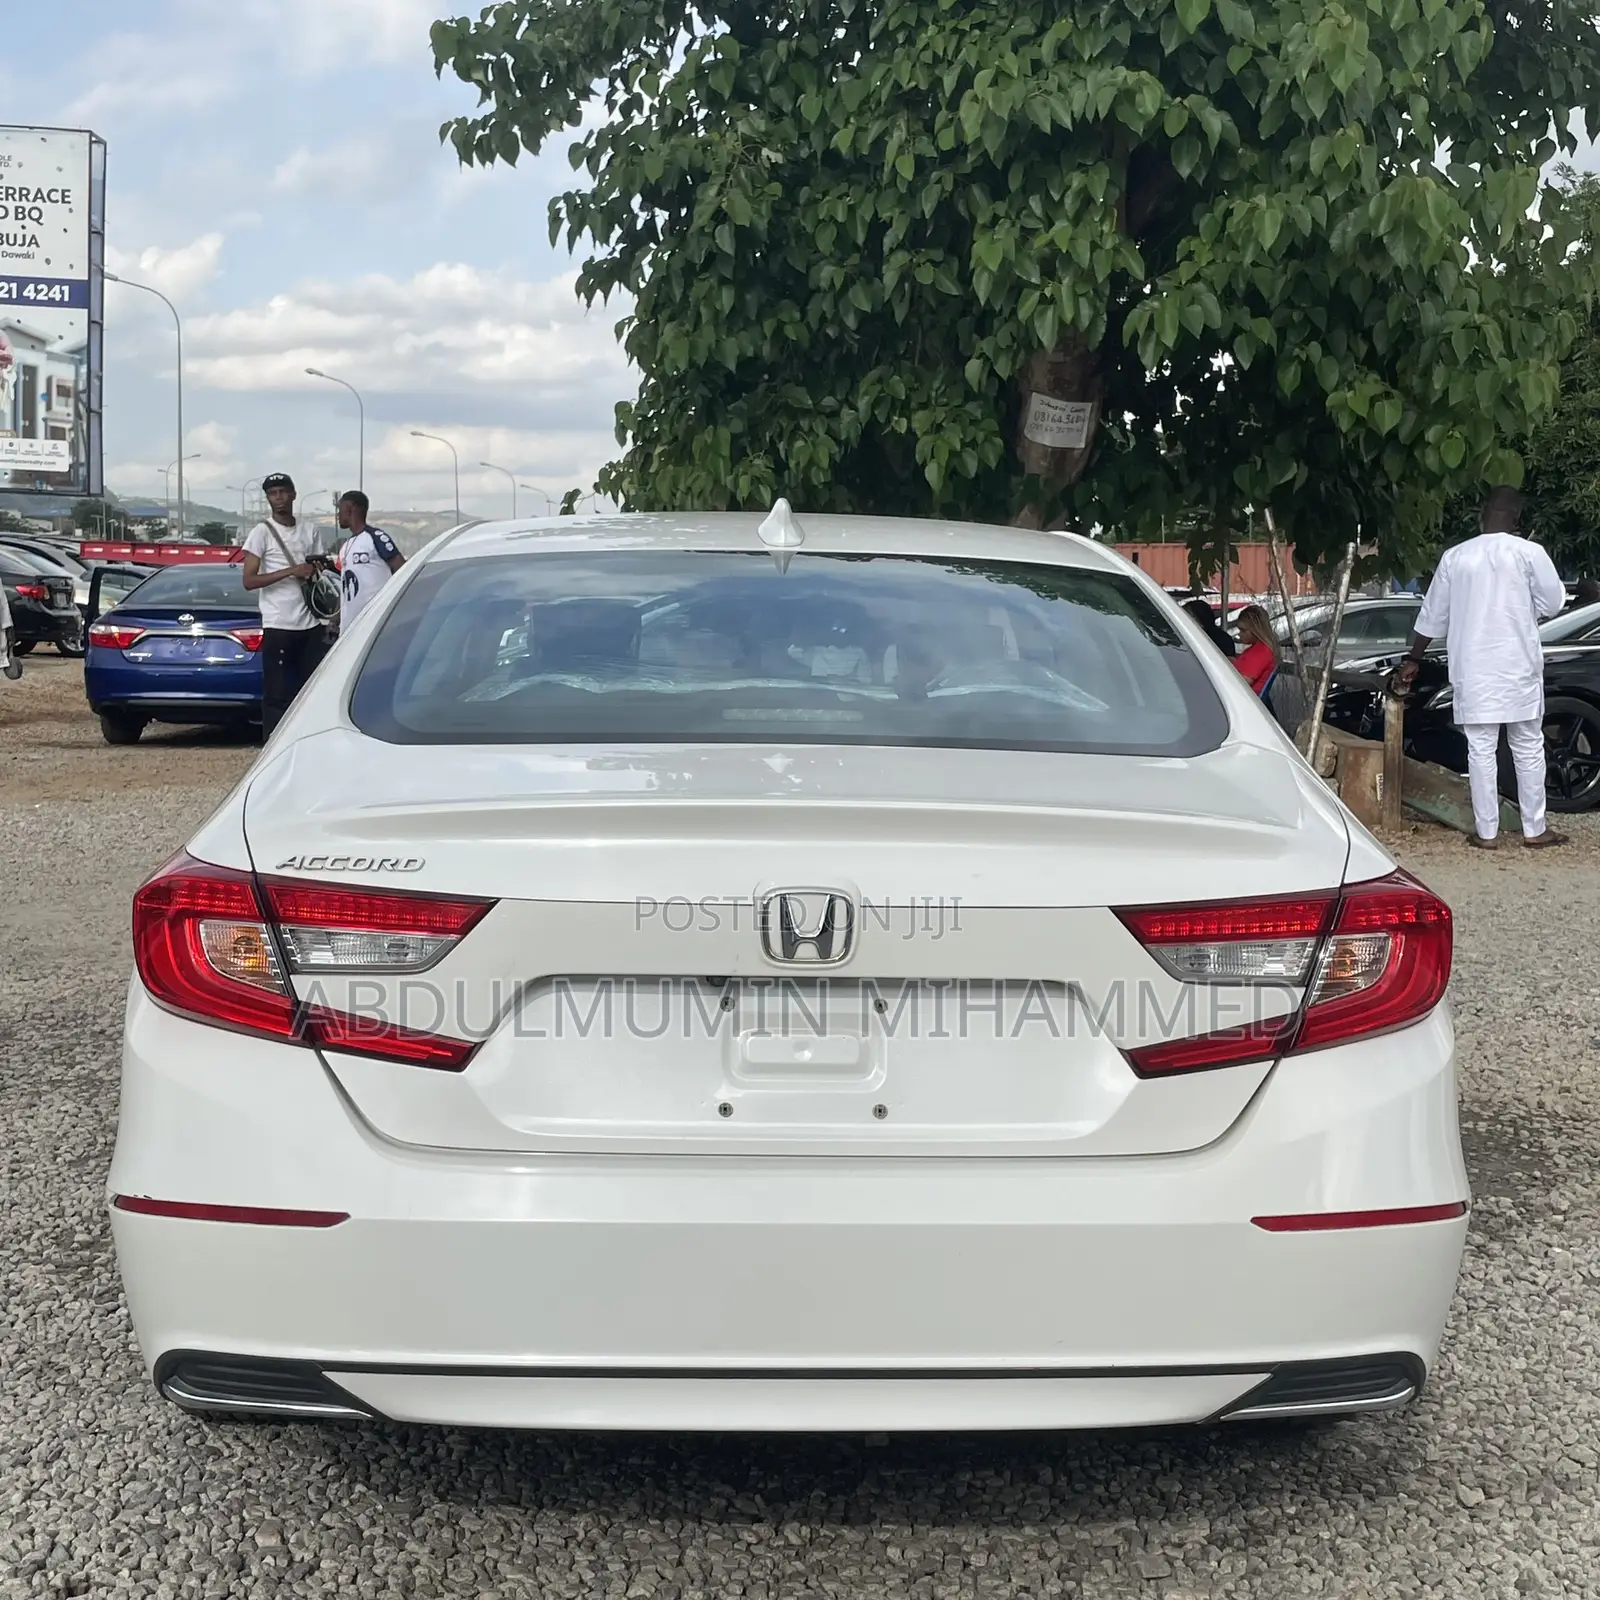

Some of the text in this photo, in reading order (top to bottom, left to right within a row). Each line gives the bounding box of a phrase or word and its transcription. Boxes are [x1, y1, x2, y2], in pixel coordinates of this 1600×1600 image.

[14, 205, 44, 226] BQ
[1, 250, 35, 260] Dawaki
[22, 283, 70, 302] 4241
[275, 855, 427, 873] ACCORD
